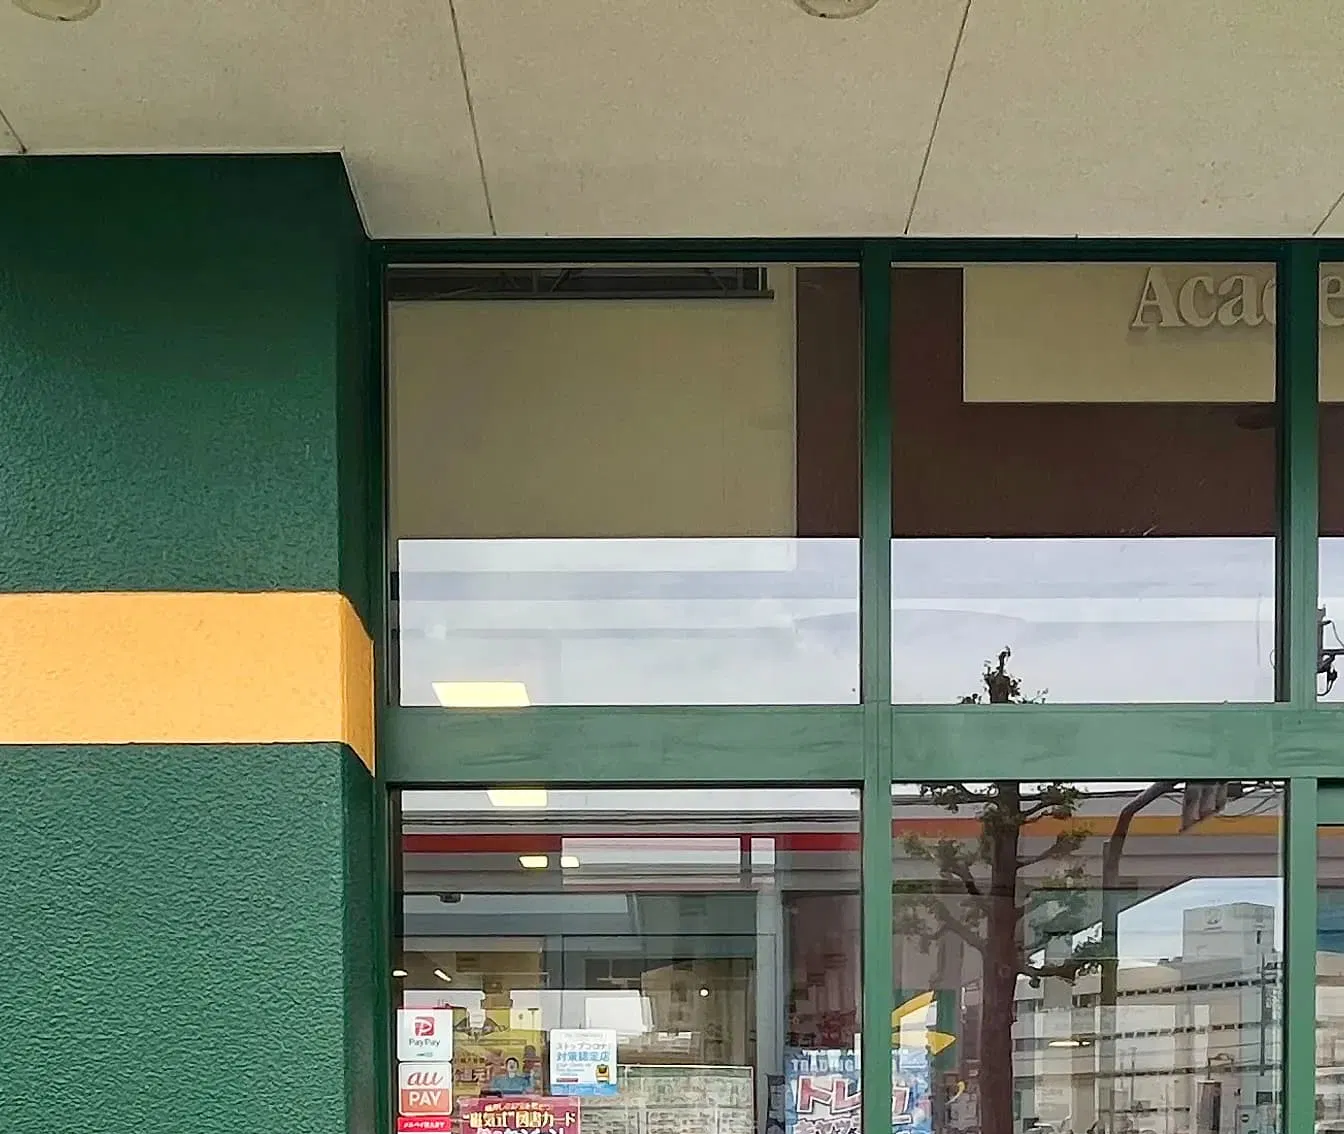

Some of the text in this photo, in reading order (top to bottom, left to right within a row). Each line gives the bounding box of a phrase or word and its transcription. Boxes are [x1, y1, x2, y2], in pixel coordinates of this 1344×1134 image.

[408, 1037, 441, 1050] PayPay
[407, 1071, 444, 1087] au
[408, 1091, 442, 1107] PAY
